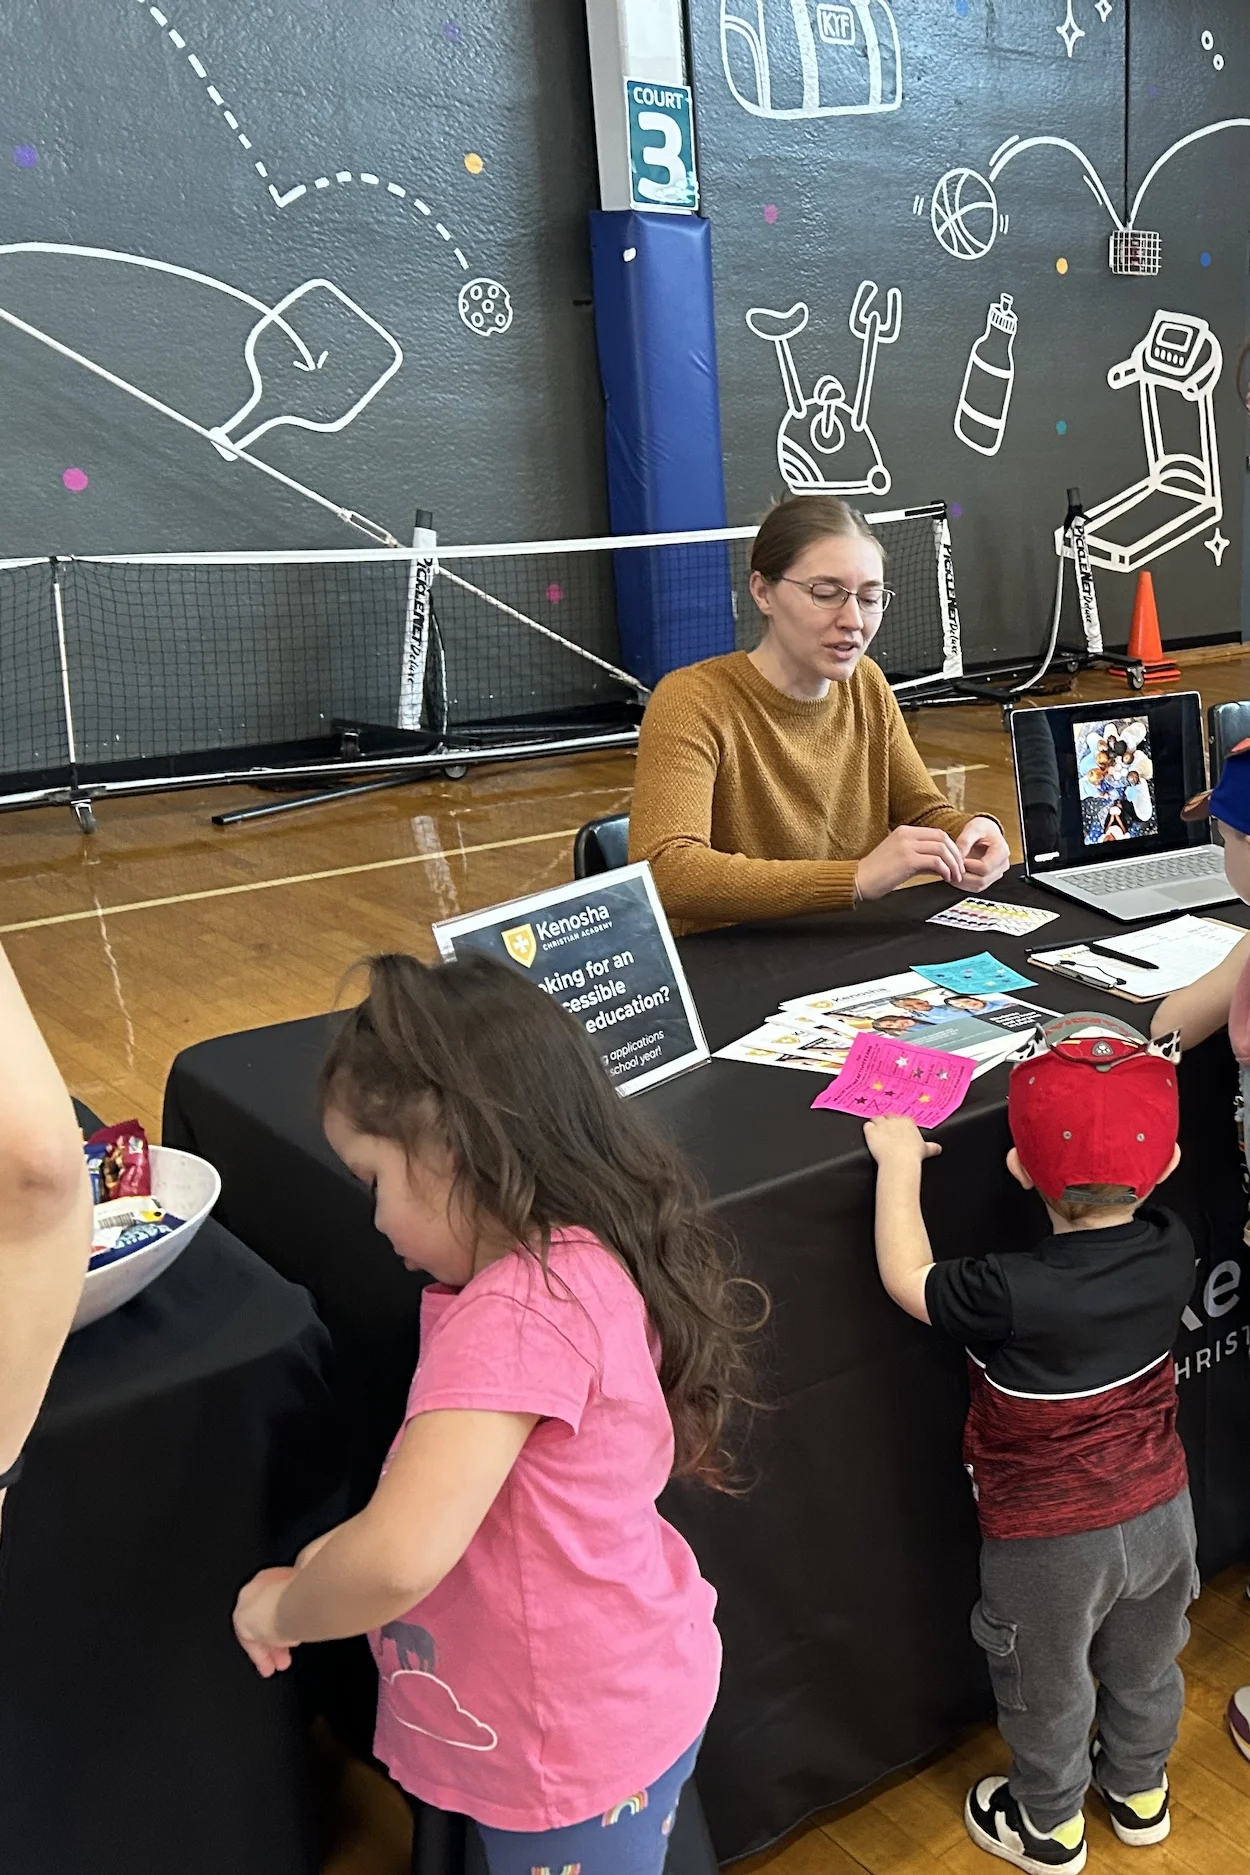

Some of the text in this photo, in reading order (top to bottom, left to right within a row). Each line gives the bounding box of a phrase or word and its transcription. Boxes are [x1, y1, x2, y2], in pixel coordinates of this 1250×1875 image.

[822, 10, 850, 38] KYF
[633, 86, 683, 109] COURT
[638, 111, 687, 203] 3
[536, 905, 610, 940] Kenosha
[543, 921, 613, 951] CHRISTIAN ACADEMY
[585, 959, 610, 979] for
[613, 950, 635, 968] an
[586, 985, 670, 1034] education?
[610, 1030, 665, 1061] applications
[610, 1055, 639, 1077] school
[640, 1045, 662, 1066] year!
